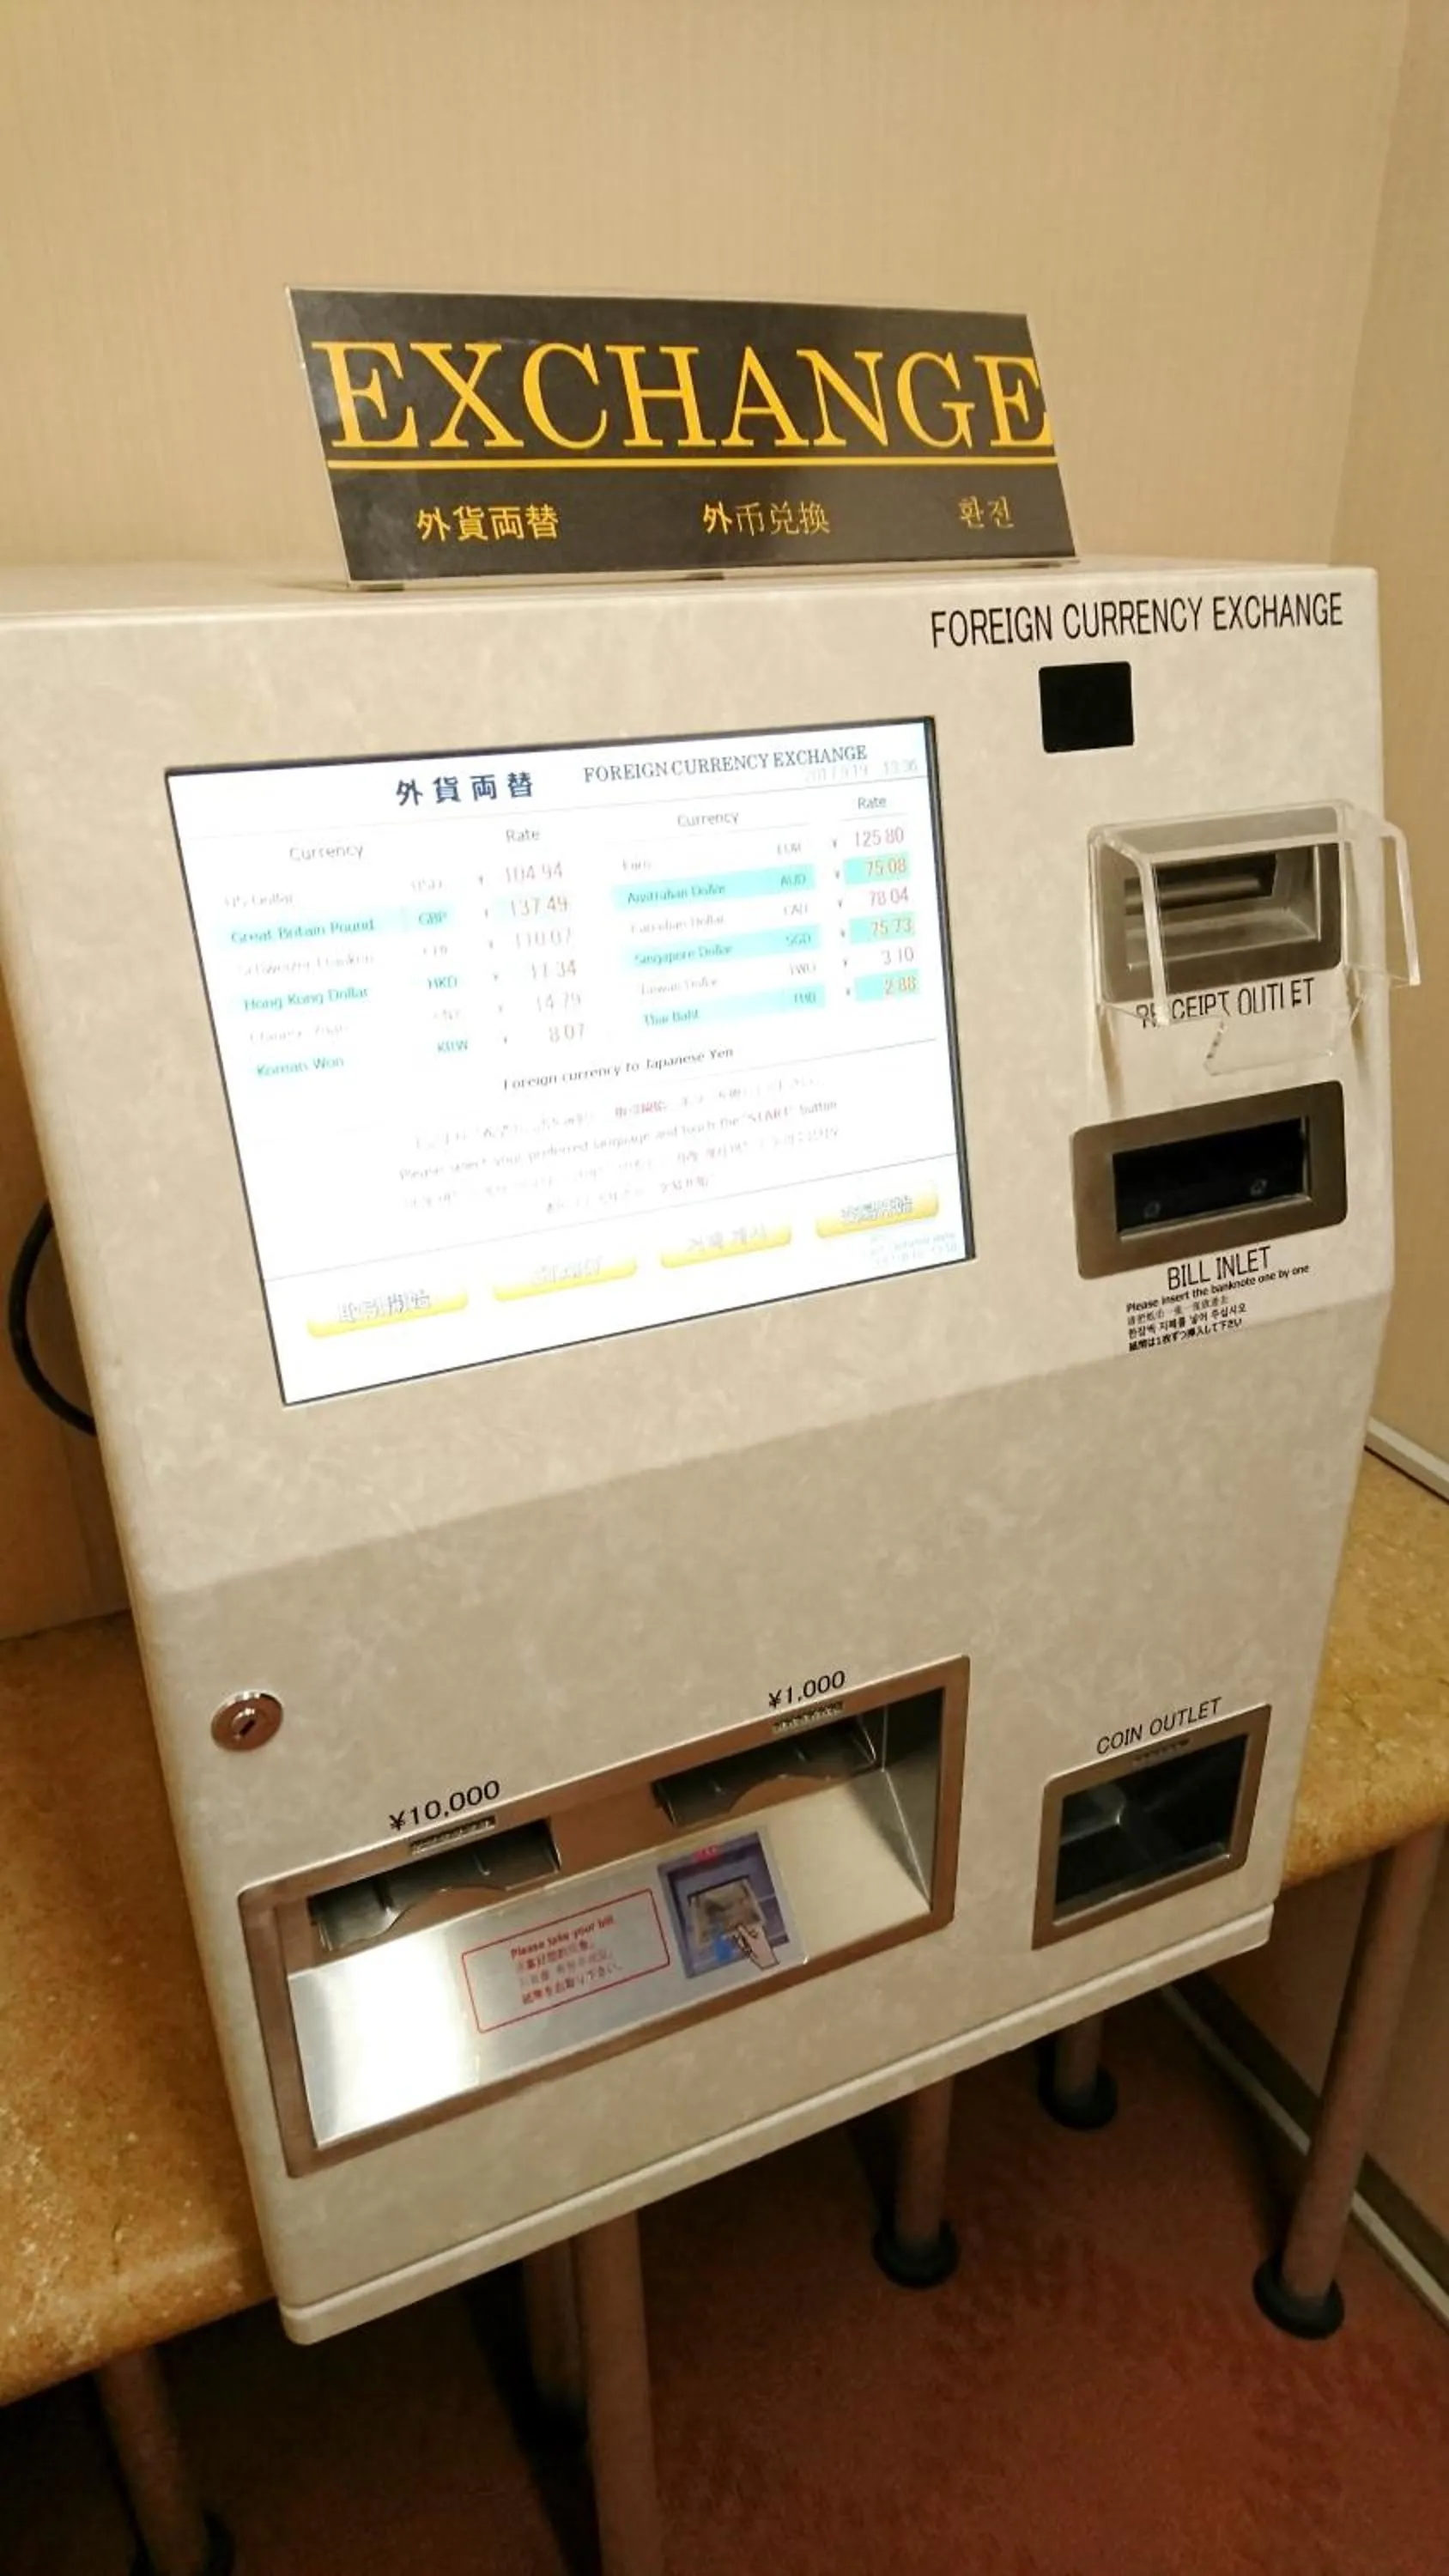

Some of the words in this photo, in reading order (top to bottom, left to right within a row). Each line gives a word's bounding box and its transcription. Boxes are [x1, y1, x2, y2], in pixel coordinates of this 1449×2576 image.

[311, 340, 1053, 452] EXCHANGE
[416, 502, 560, 543] 外貨両替
[957, 495, 1016, 530] 환전
[931, 604, 1054, 648] FOREIGN
[1062, 595, 1203, 641] CURRENCY
[1212, 592, 1344, 632] EXCHANGE
[583, 760, 669, 783] FOREIGN
[671, 751, 771, 777] CURRENCY
[773, 744, 869, 769] EXCHANGE
[395, 772, 534, 807] 外貨両替
[858, 795, 888, 811] Rate
[505, 827, 542, 844] Rate
[676, 811, 740, 828] Currency
[288, 842, 364, 861] Currency
[502, 1072, 558, 1091] Foreign
[561, 1066, 621, 1084] currency
[625, 1061, 640, 1073] to
[646, 1053, 706, 1071] Japanese
[709, 1047, 734, 1060] Yen
[1167, 1261, 1211, 1291] BILL
[1215, 1245, 1271, 1281] INLET
[1125, 1298, 1159, 1314] Please
[1161, 1291, 1190, 1305] insert
[1192, 1286, 1210, 1298] the
[1210, 1277, 1256, 1295] banknote
[1258, 1273, 1276, 1283] one
[1278, 1269, 1290, 1280] by
[1292, 1264, 1311, 1275] one
[768, 1669, 846, 1710] ¥1,000
[1096, 1723, 1143, 1755] COIN
[1149, 1696, 1223, 1737] OUTLET
[388, 1779, 501, 1832] ¥10,000
[511, 1940, 545, 1960] Please
[573, 1923, 595, 1941] your
